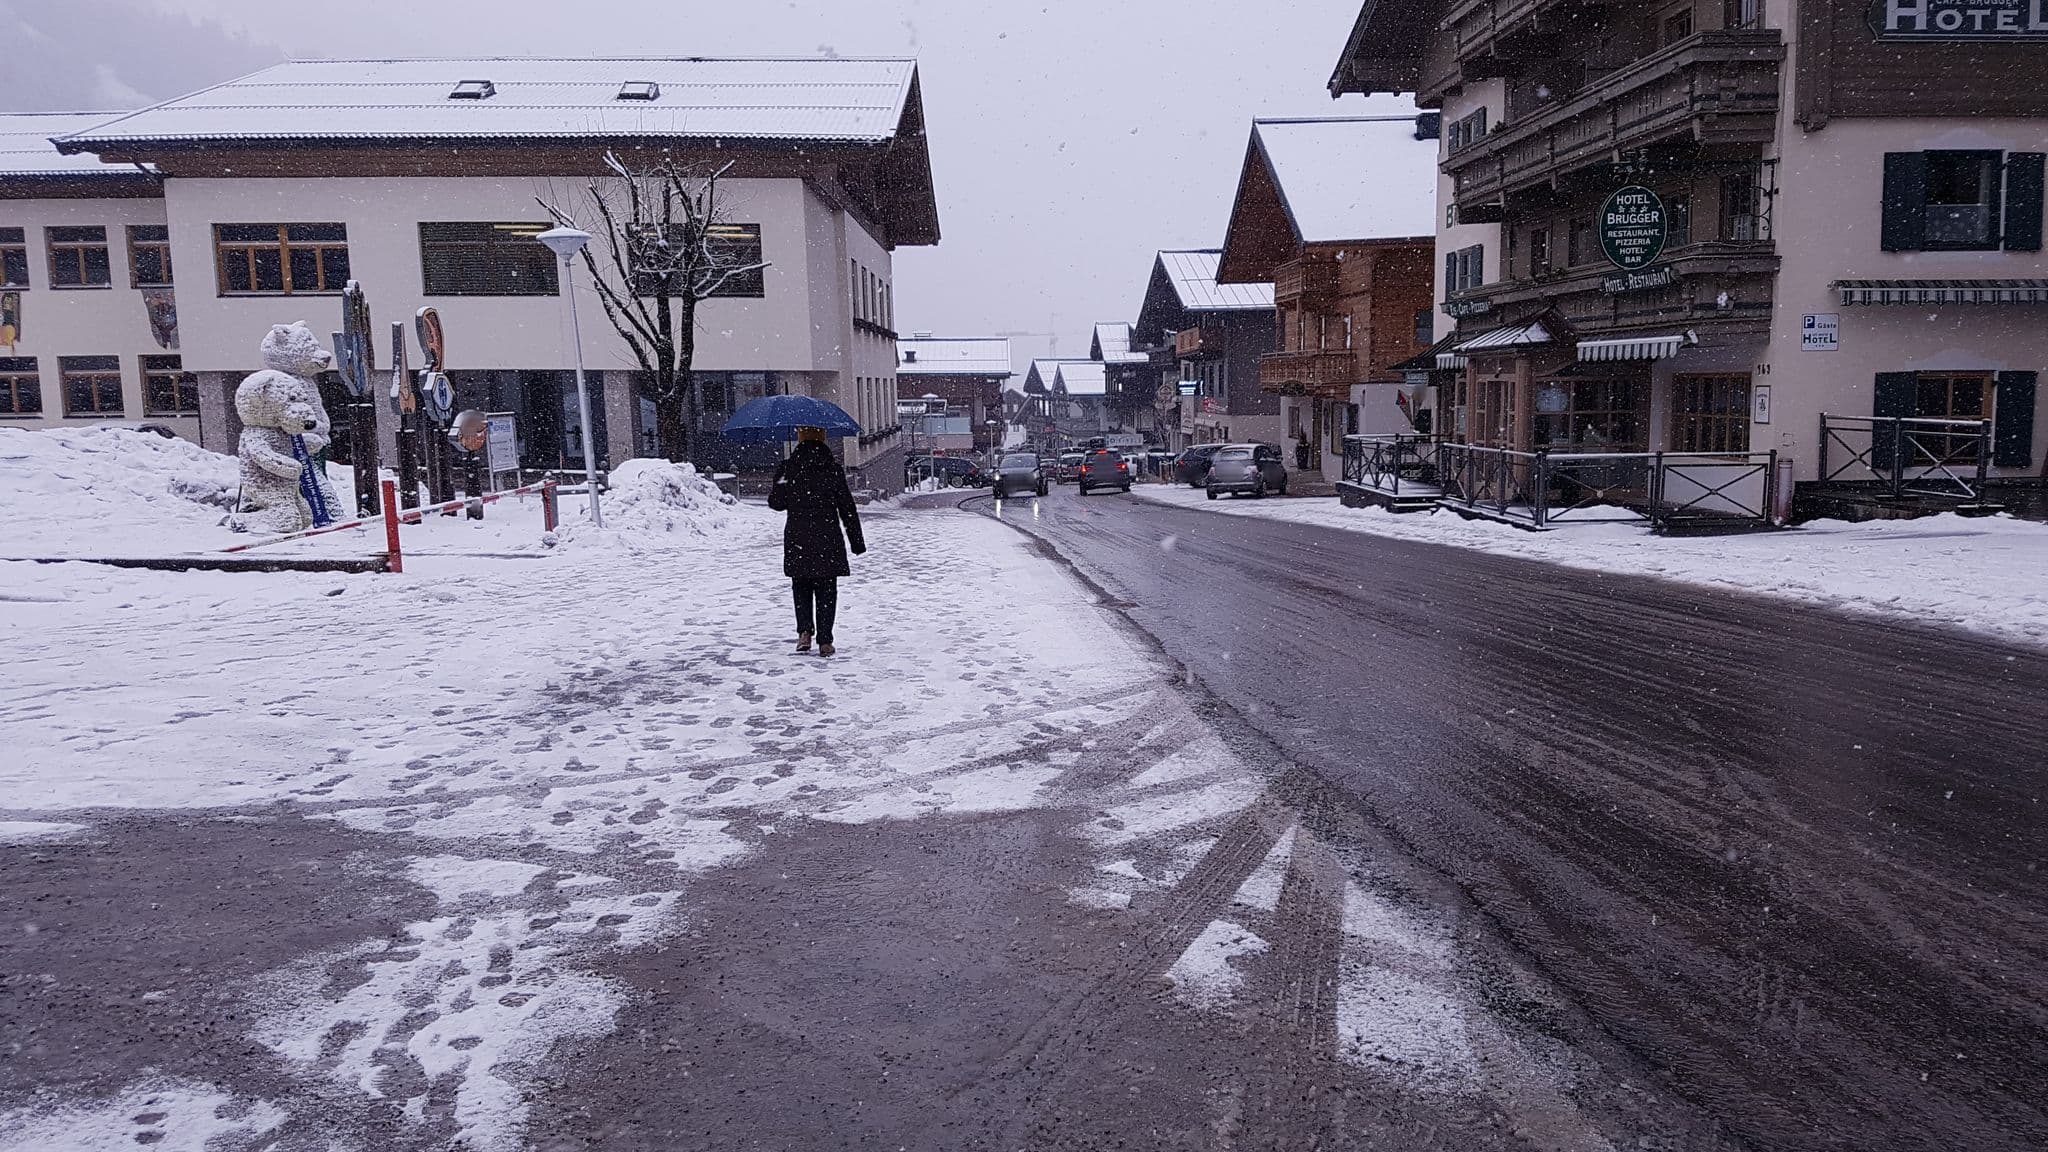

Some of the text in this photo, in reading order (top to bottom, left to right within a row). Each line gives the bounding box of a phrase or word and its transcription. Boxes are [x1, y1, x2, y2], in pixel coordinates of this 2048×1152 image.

[1885, 0, 2048, 31] HOTEL
[1616, 194, 1650, 205] HOTEL
[1607, 211, 1660, 225] BRUGGER
[1615, 238, 1651, 246] PIZZERIA
[1625, 256, 1642, 264] BAR
[1805, 316, 1814, 328] P
[1803, 333, 1837, 344] HOTEL
